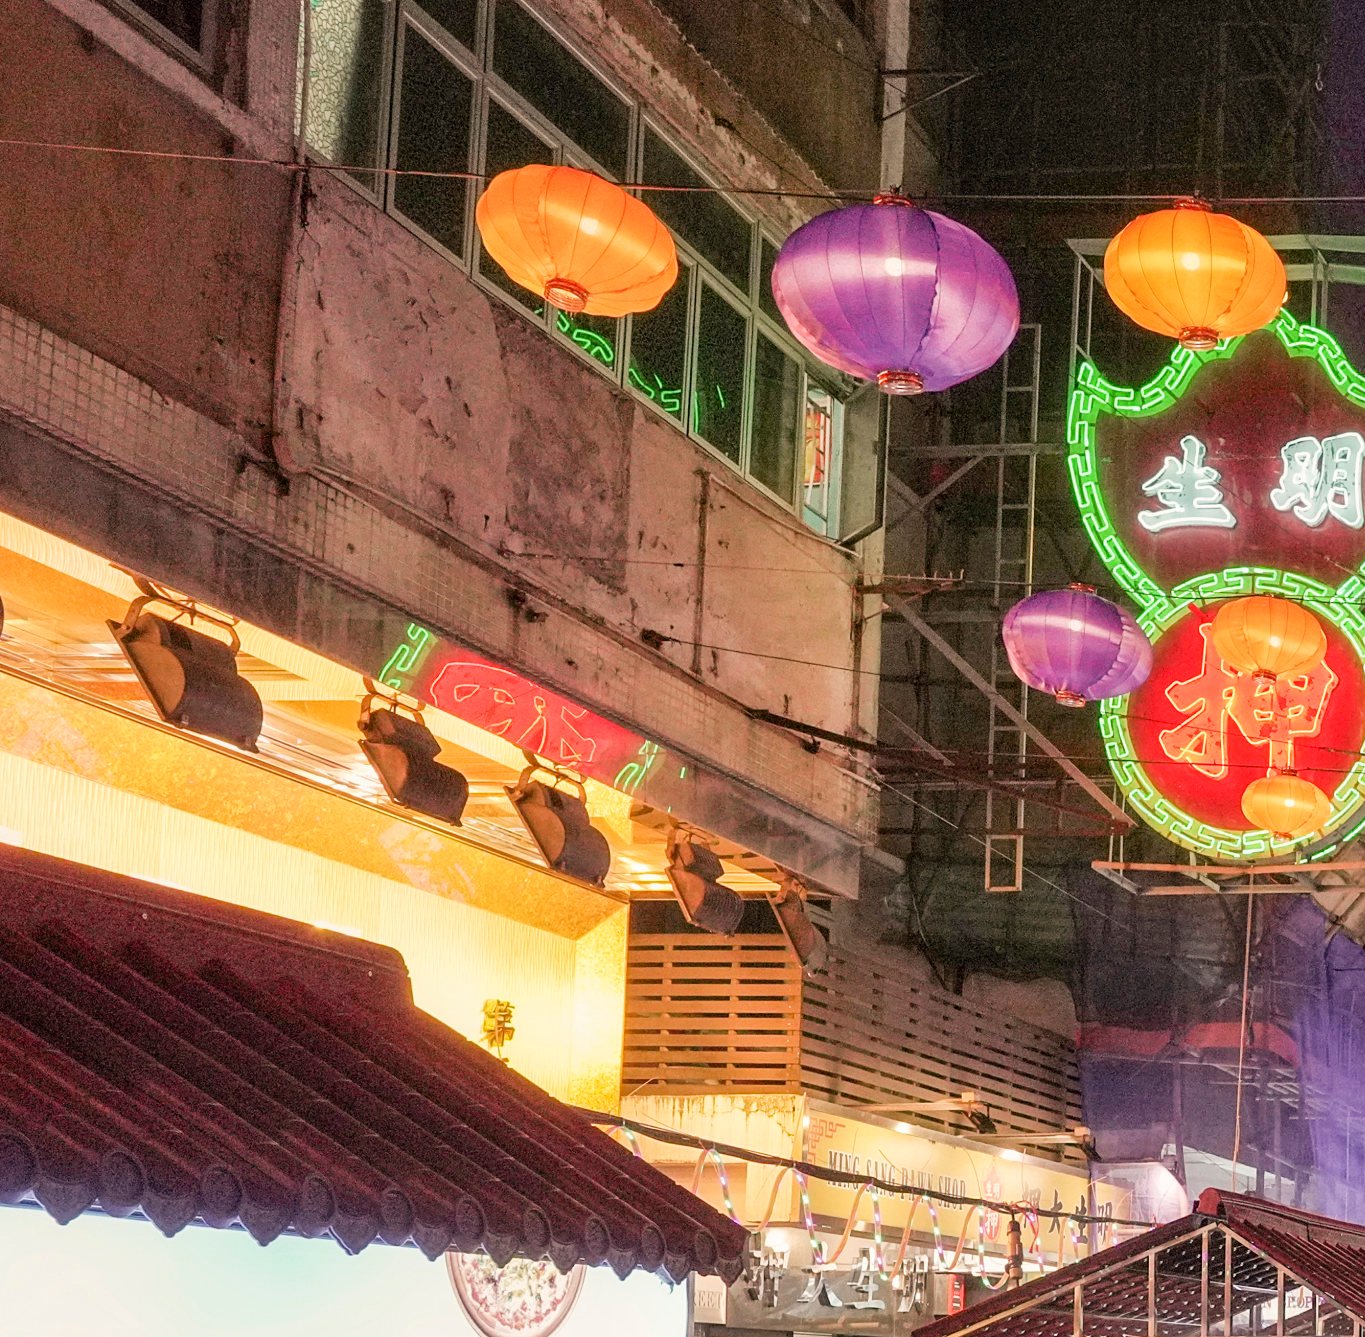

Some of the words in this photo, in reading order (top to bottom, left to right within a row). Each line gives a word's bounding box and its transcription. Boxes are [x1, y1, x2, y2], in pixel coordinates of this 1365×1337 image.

[828, 1150, 860, 1190] MING
[866, 1158, 897, 1198] SANG
[938, 1175, 966, 1211] SHOP
[984, 1211, 1001, 1235] 押
